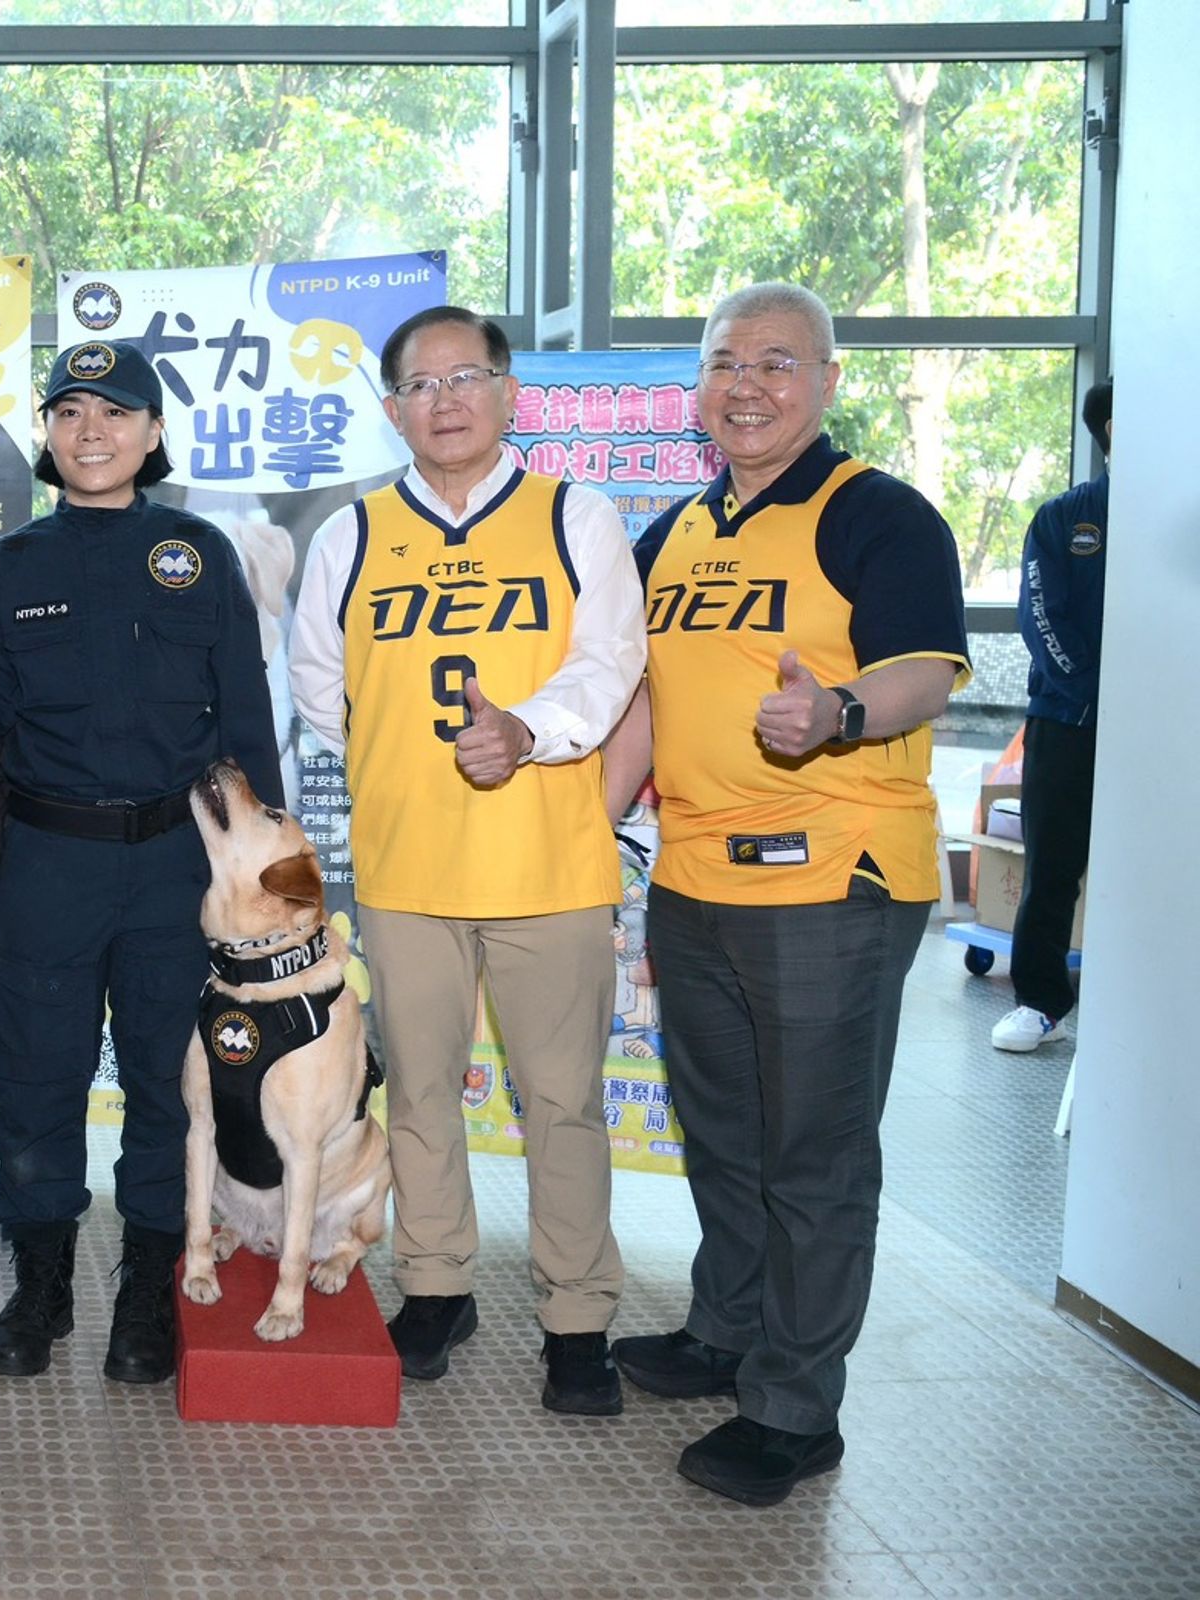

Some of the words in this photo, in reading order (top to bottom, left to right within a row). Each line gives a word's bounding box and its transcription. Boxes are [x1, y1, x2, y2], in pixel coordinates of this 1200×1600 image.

[280, 277, 339, 295] NTPD
[345, 274, 381, 290] K-9
[387, 268, 431, 286] Unit
[116, 311, 270, 406] 犬力
[504, 386, 706, 432] 當詐騙集團
[190, 387, 354, 489] 出擊
[427, 560, 484, 577] CTBC
[691, 561, 741, 575] CTBC
[1028, 559, 1043, 589] NEW
[16, 607, 46, 620] NTPD
[47, 603, 68, 615] K-9
[368, 576, 549, 641] DEA
[647, 579, 788, 635] DEA
[1031, 593, 1051, 633] TAIPEI
[1043, 632, 1077, 674] POLICE
[430, 654, 477, 743] 9
[302, 775, 349, 787] 眾安全
[271, 944, 310, 979] NTPD
[602, 1076, 672, 1106] 警察局
